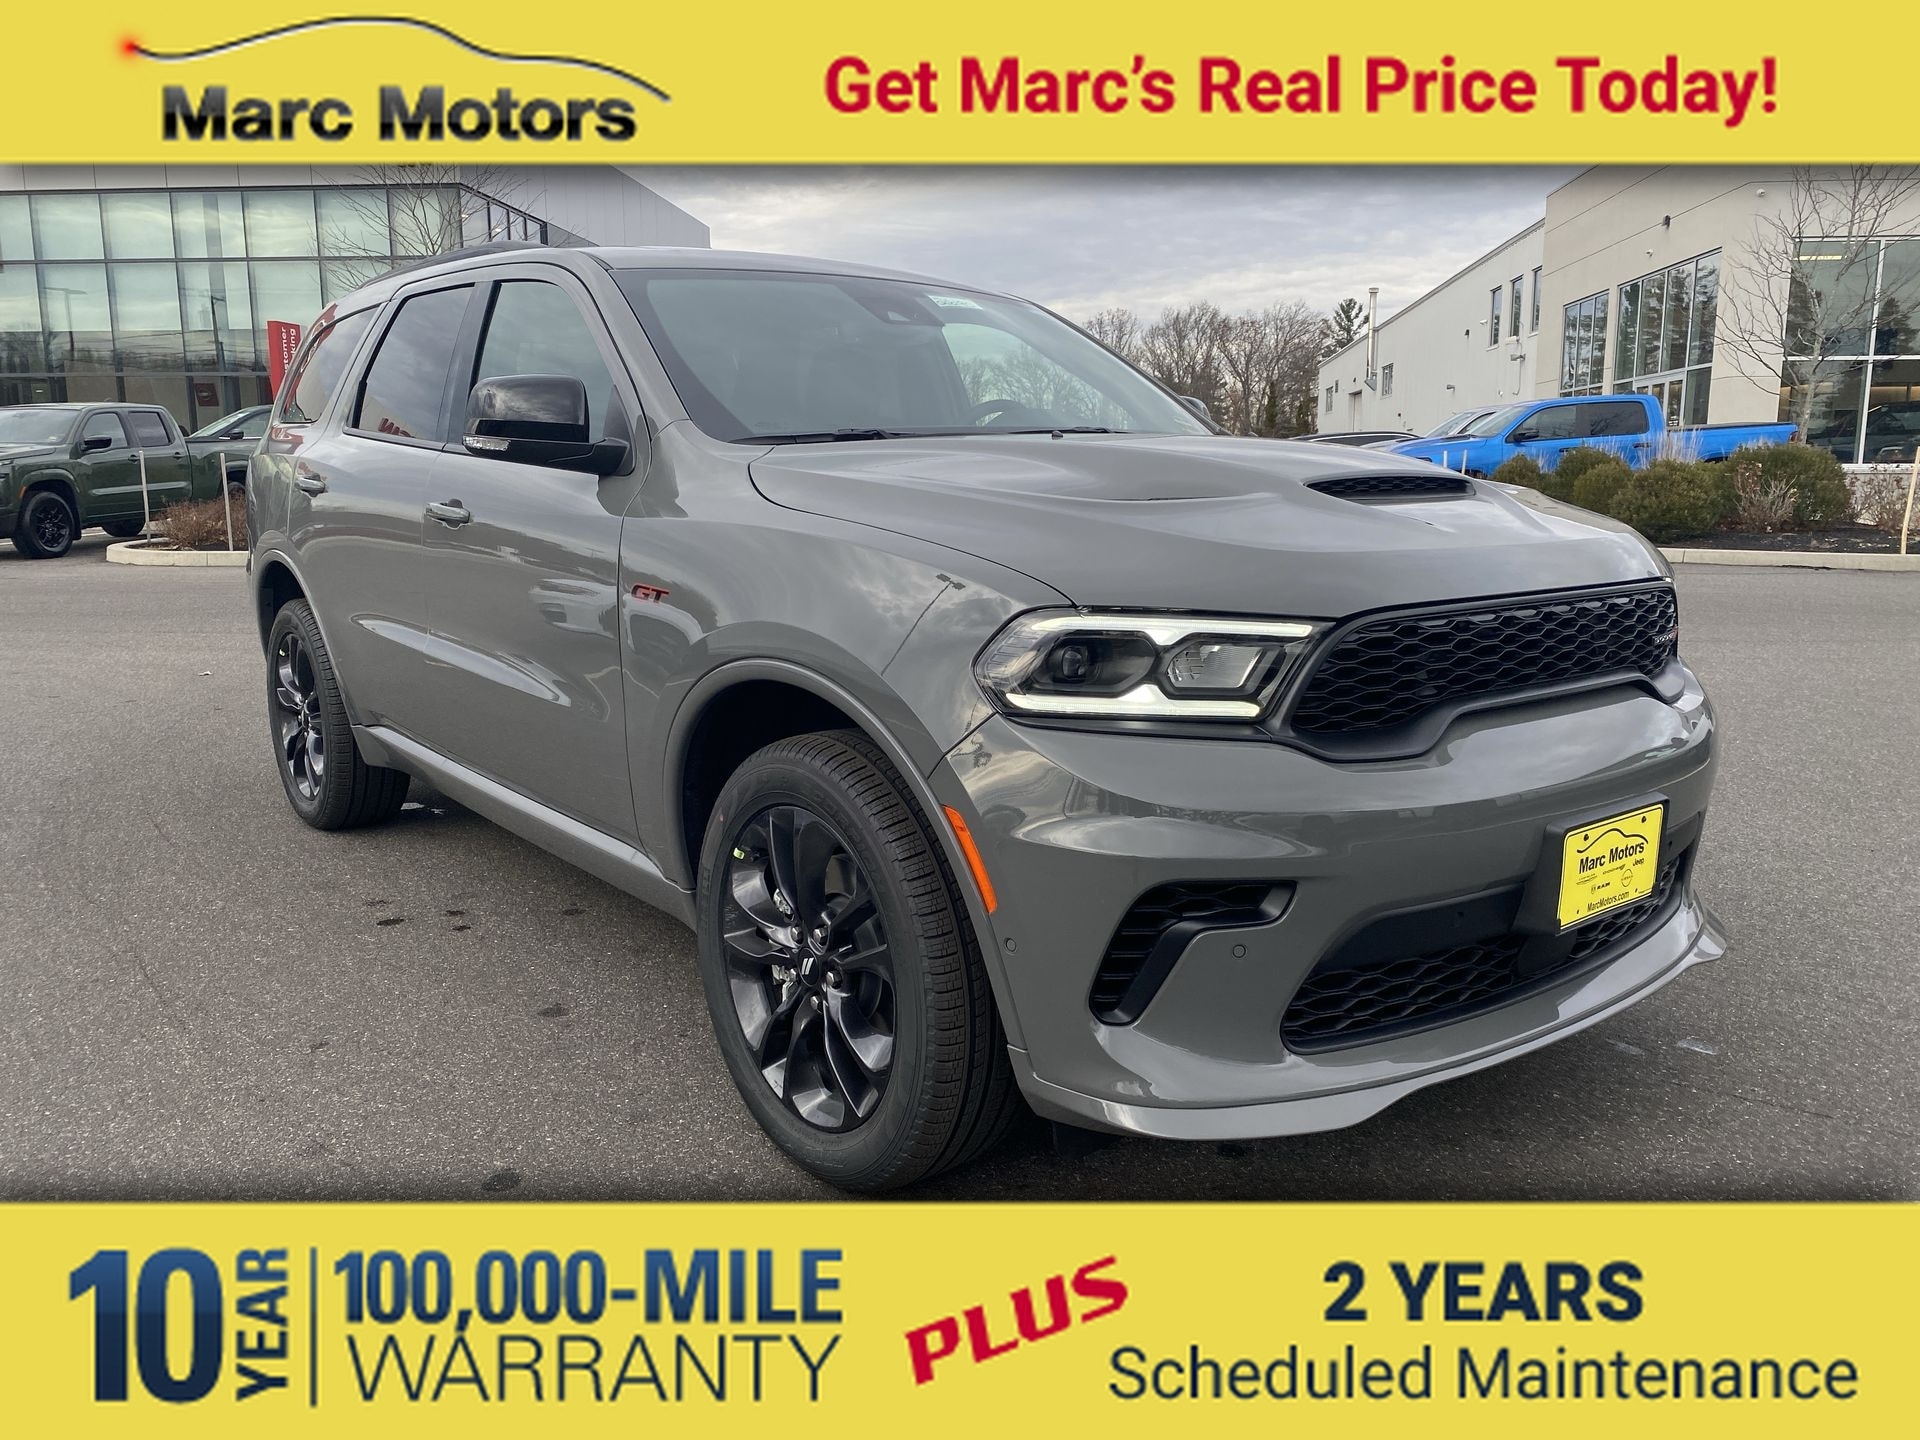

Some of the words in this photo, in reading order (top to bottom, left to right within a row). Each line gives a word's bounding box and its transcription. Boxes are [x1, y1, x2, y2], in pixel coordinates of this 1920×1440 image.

[281, 326, 289, 373] stomer
[631, 584, 670, 603] GT
[1578, 855, 1605, 874] Marc
[1608, 842, 1645, 864] Motors
[1587, 891, 1630, 912] MarcMotors.com
